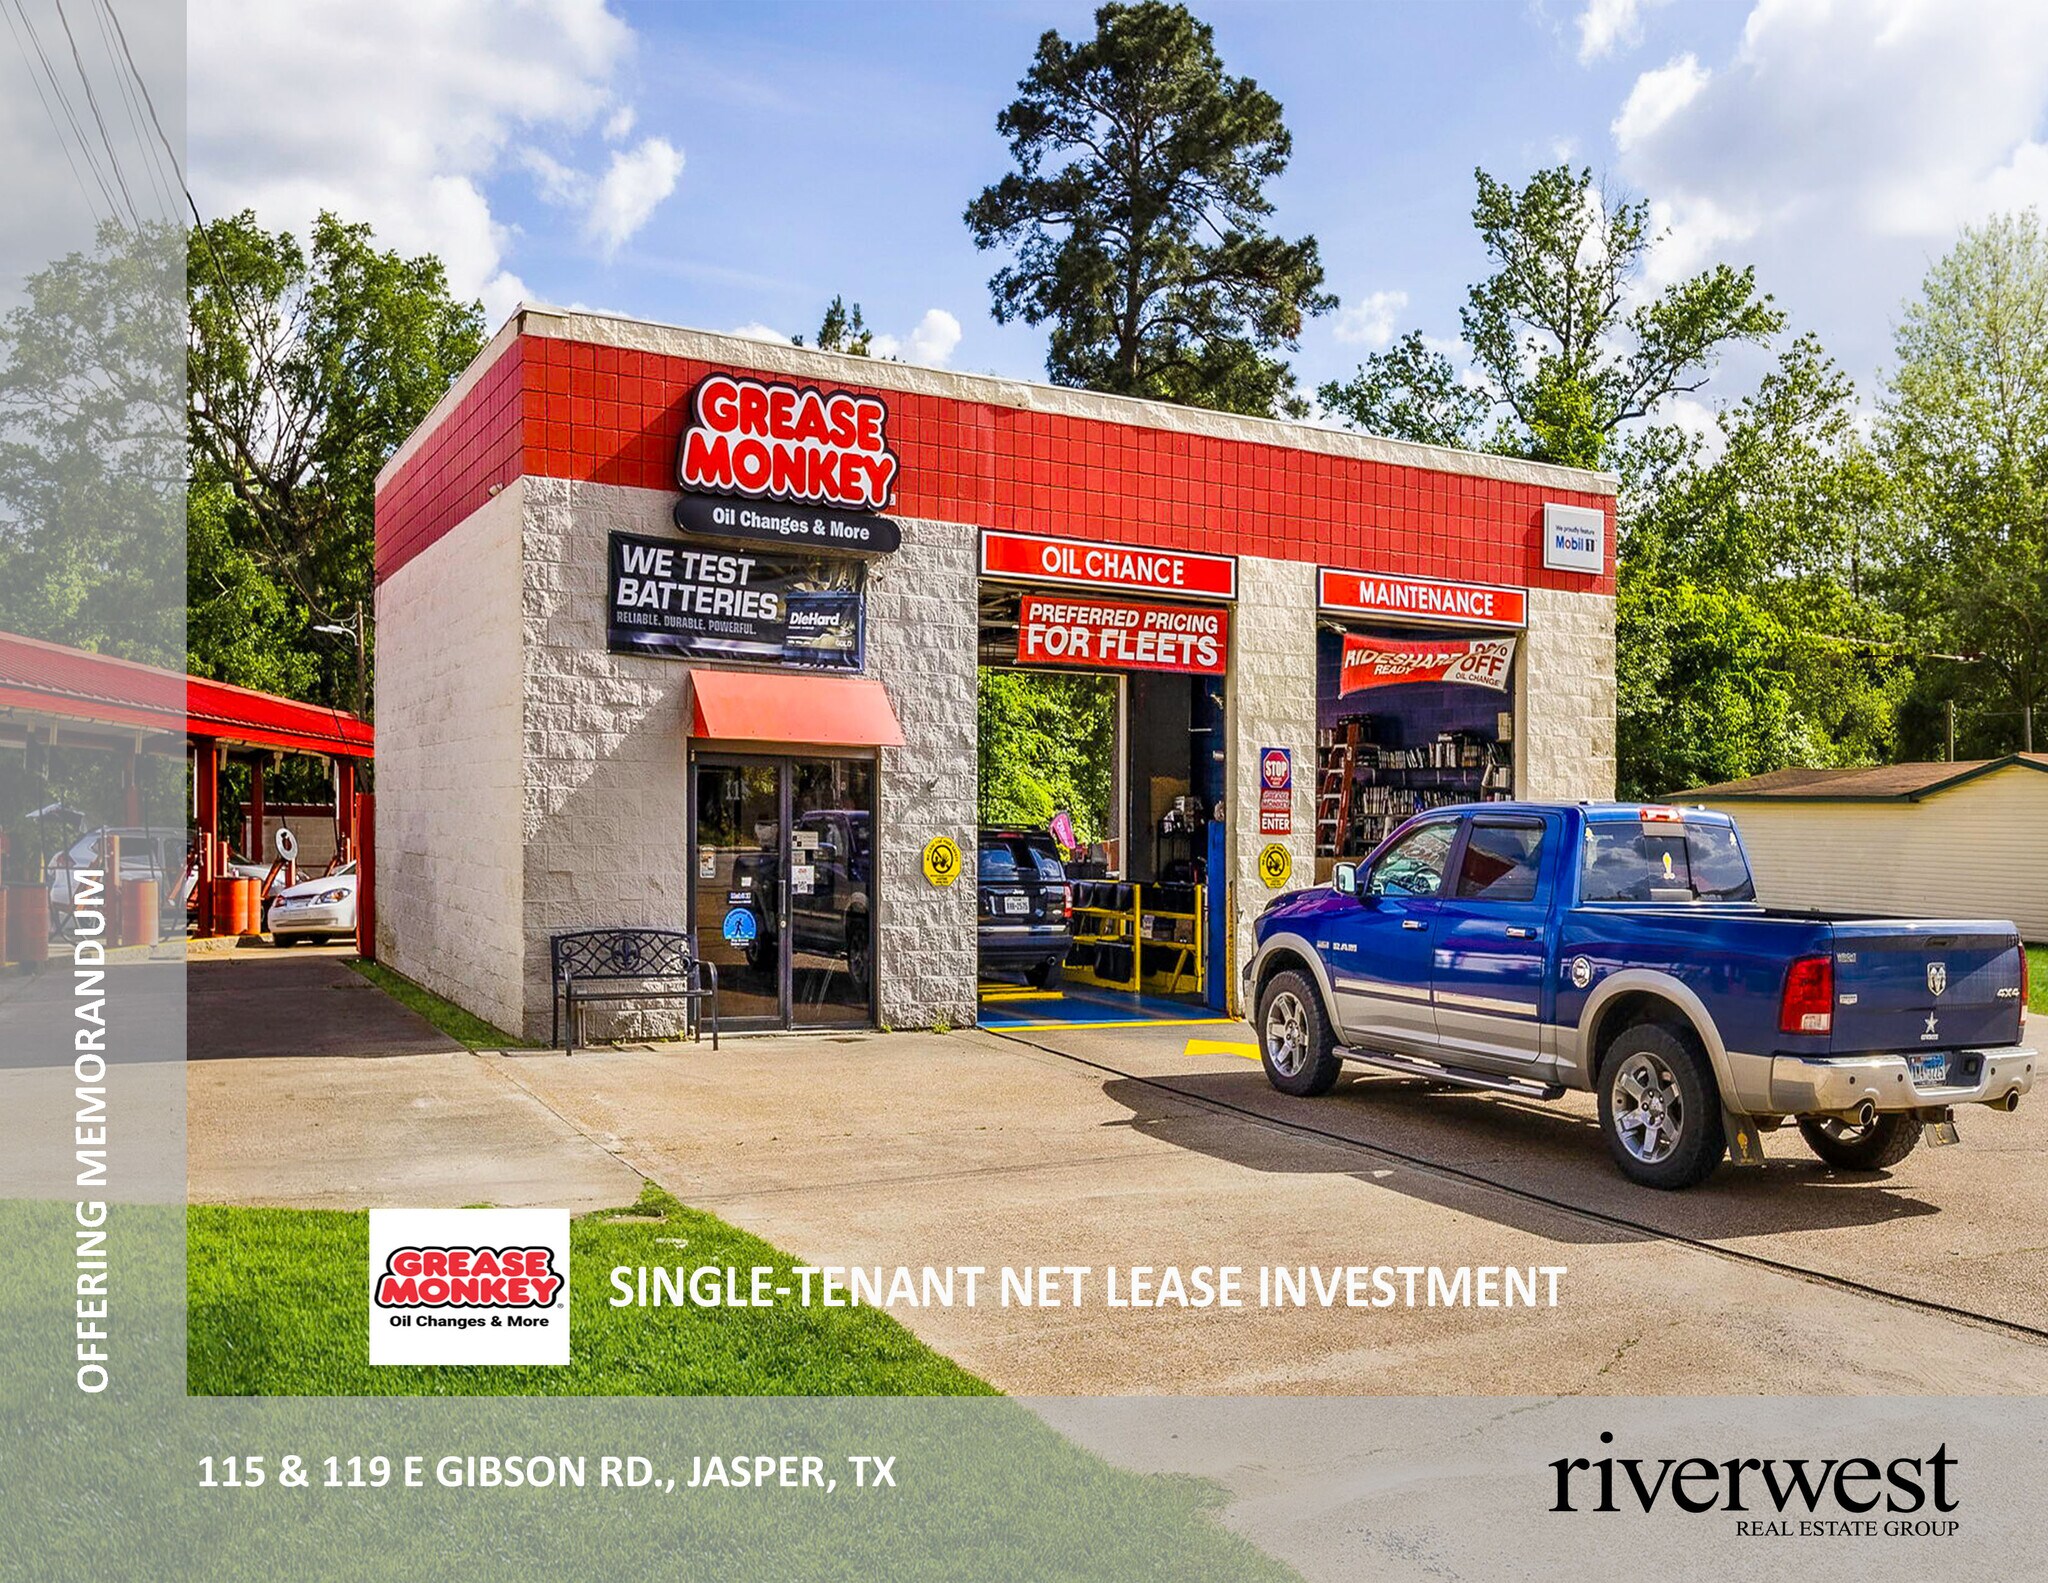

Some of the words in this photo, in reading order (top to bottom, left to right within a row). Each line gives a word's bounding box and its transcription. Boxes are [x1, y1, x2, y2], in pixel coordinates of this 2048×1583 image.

[702, 382, 882, 451] GREASE
[685, 432, 893, 508] MONKEY
[713, 507, 735, 525] Oil
[740, 512, 808, 535] Changes
[813, 518, 826, 534] &
[831, 521, 869, 540] More
[1556, 536, 1584, 551] Mobil
[1586, 539, 1594, 552] 1
[622, 545, 672, 577] WE
[682, 552, 755, 585] TEST
[1042, 546, 1081, 575] OIL
[617, 578, 777, 620] BATTERIES
[1359, 580, 1494, 616] MAINTENANCE
[617, 611, 661, 626] RELIABLE.
[664, 615, 706, 630] DURABLE.
[709, 620, 757, 635] POWERFUL.
[789, 611, 840, 626] DieHard
[1029, 603, 1139, 628] PREFERRED
[1144, 611, 1218, 634] PRICING
[1027, 624, 1090, 657] FOR
[1100, 629, 1218, 666] FLEETS
[1374, 665, 1414, 676] READY
[1460, 654, 1505, 676] OFF
[1456, 672, 1467, 680] OIL
[1469, 674, 1501, 686] CHANGE
[1265, 761, 1287, 777] STOP
[1262, 818, 1290, 830] ENTER
[1333, 942, 1357, 952] RAM
[1997, 988, 2020, 998] 4X4
